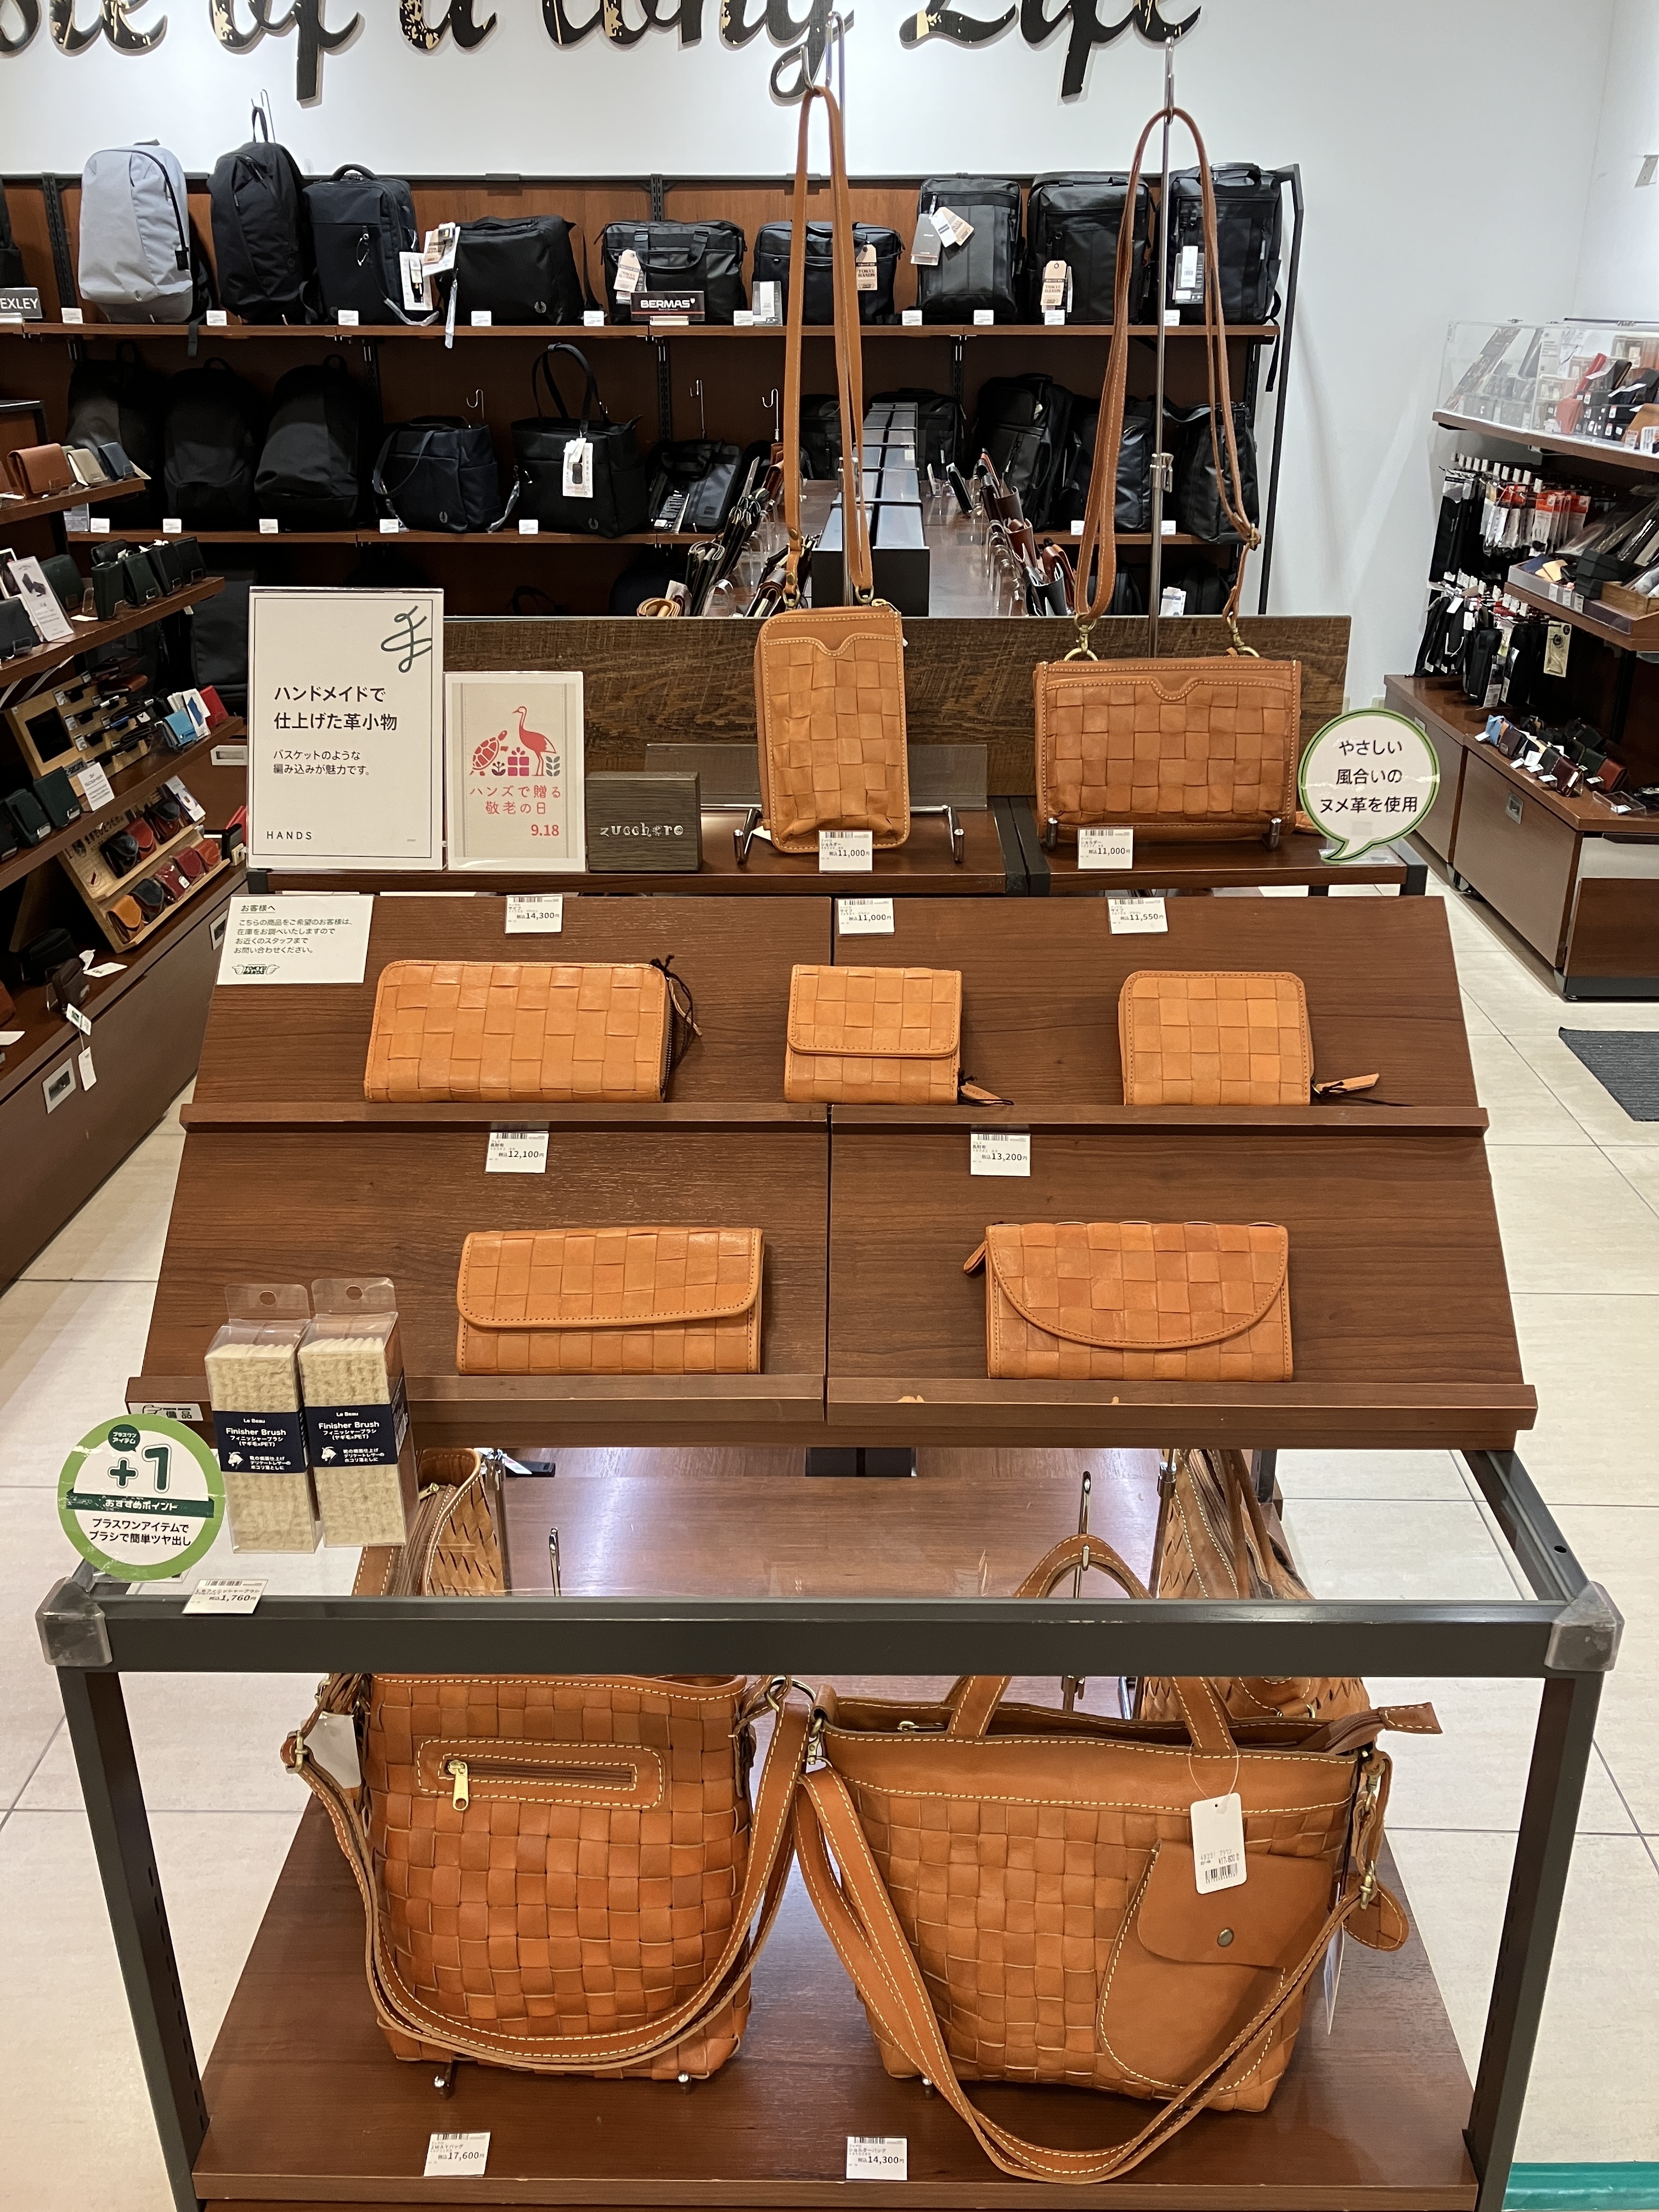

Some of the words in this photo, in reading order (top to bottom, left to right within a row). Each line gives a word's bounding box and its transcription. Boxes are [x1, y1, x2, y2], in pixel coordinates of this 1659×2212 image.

[0, 298, 38, 309] EXLEY
[640, 300, 690, 308] BERMAS
[274, 686, 386, 703] ハンドメイドで
[274, 713, 398, 731] 仕上げた革小物
[1339, 740, 1402, 755] やさしい
[273, 750, 361, 760] バスケットのような
[273, 764, 369, 776] 編み込みが魅力です。
[1336, 769, 1402, 785] 風合いの
[470, 785, 561, 799] ハンズで贈る
[485, 801, 546, 815] 敬老の日
[1320, 797, 1418, 813] ヌメ革を使用
[267, 831, 313, 840] HANDS
[531, 825, 560, 837] 9.18
[105, 1499, 178, 1511] おすすめポイント
[92, 1518, 189, 1533] プラスワンアイテムで
[89, 1531, 191, 1547] ブラシで簡単ツヤ出し
